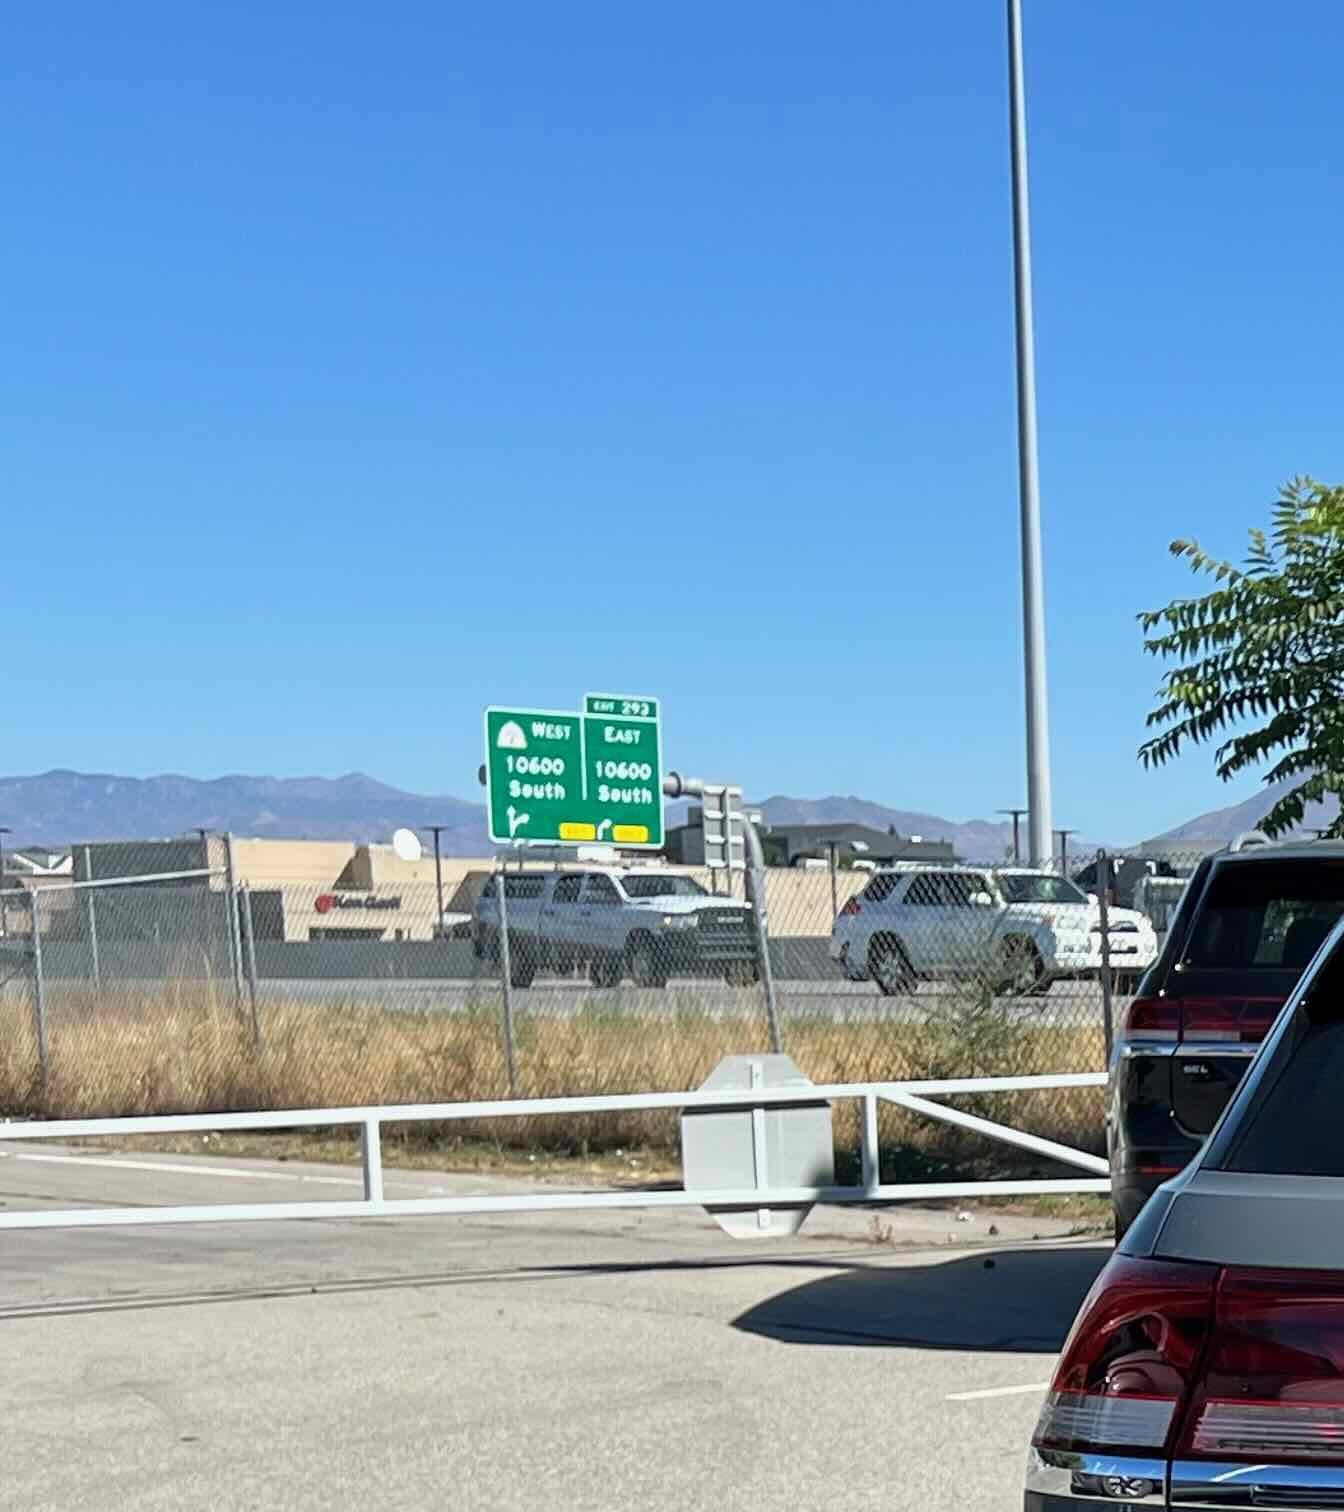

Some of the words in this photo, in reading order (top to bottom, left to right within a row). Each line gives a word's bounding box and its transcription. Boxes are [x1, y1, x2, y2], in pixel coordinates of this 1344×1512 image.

[621, 701, 650, 716] 293
[530, 721, 572, 740] WEST
[604, 726, 641, 745] EAST
[506, 755, 565, 776] 10600
[596, 760, 652, 780] 10600
[509, 779, 566, 800] South
[598, 784, 653, 804] South
